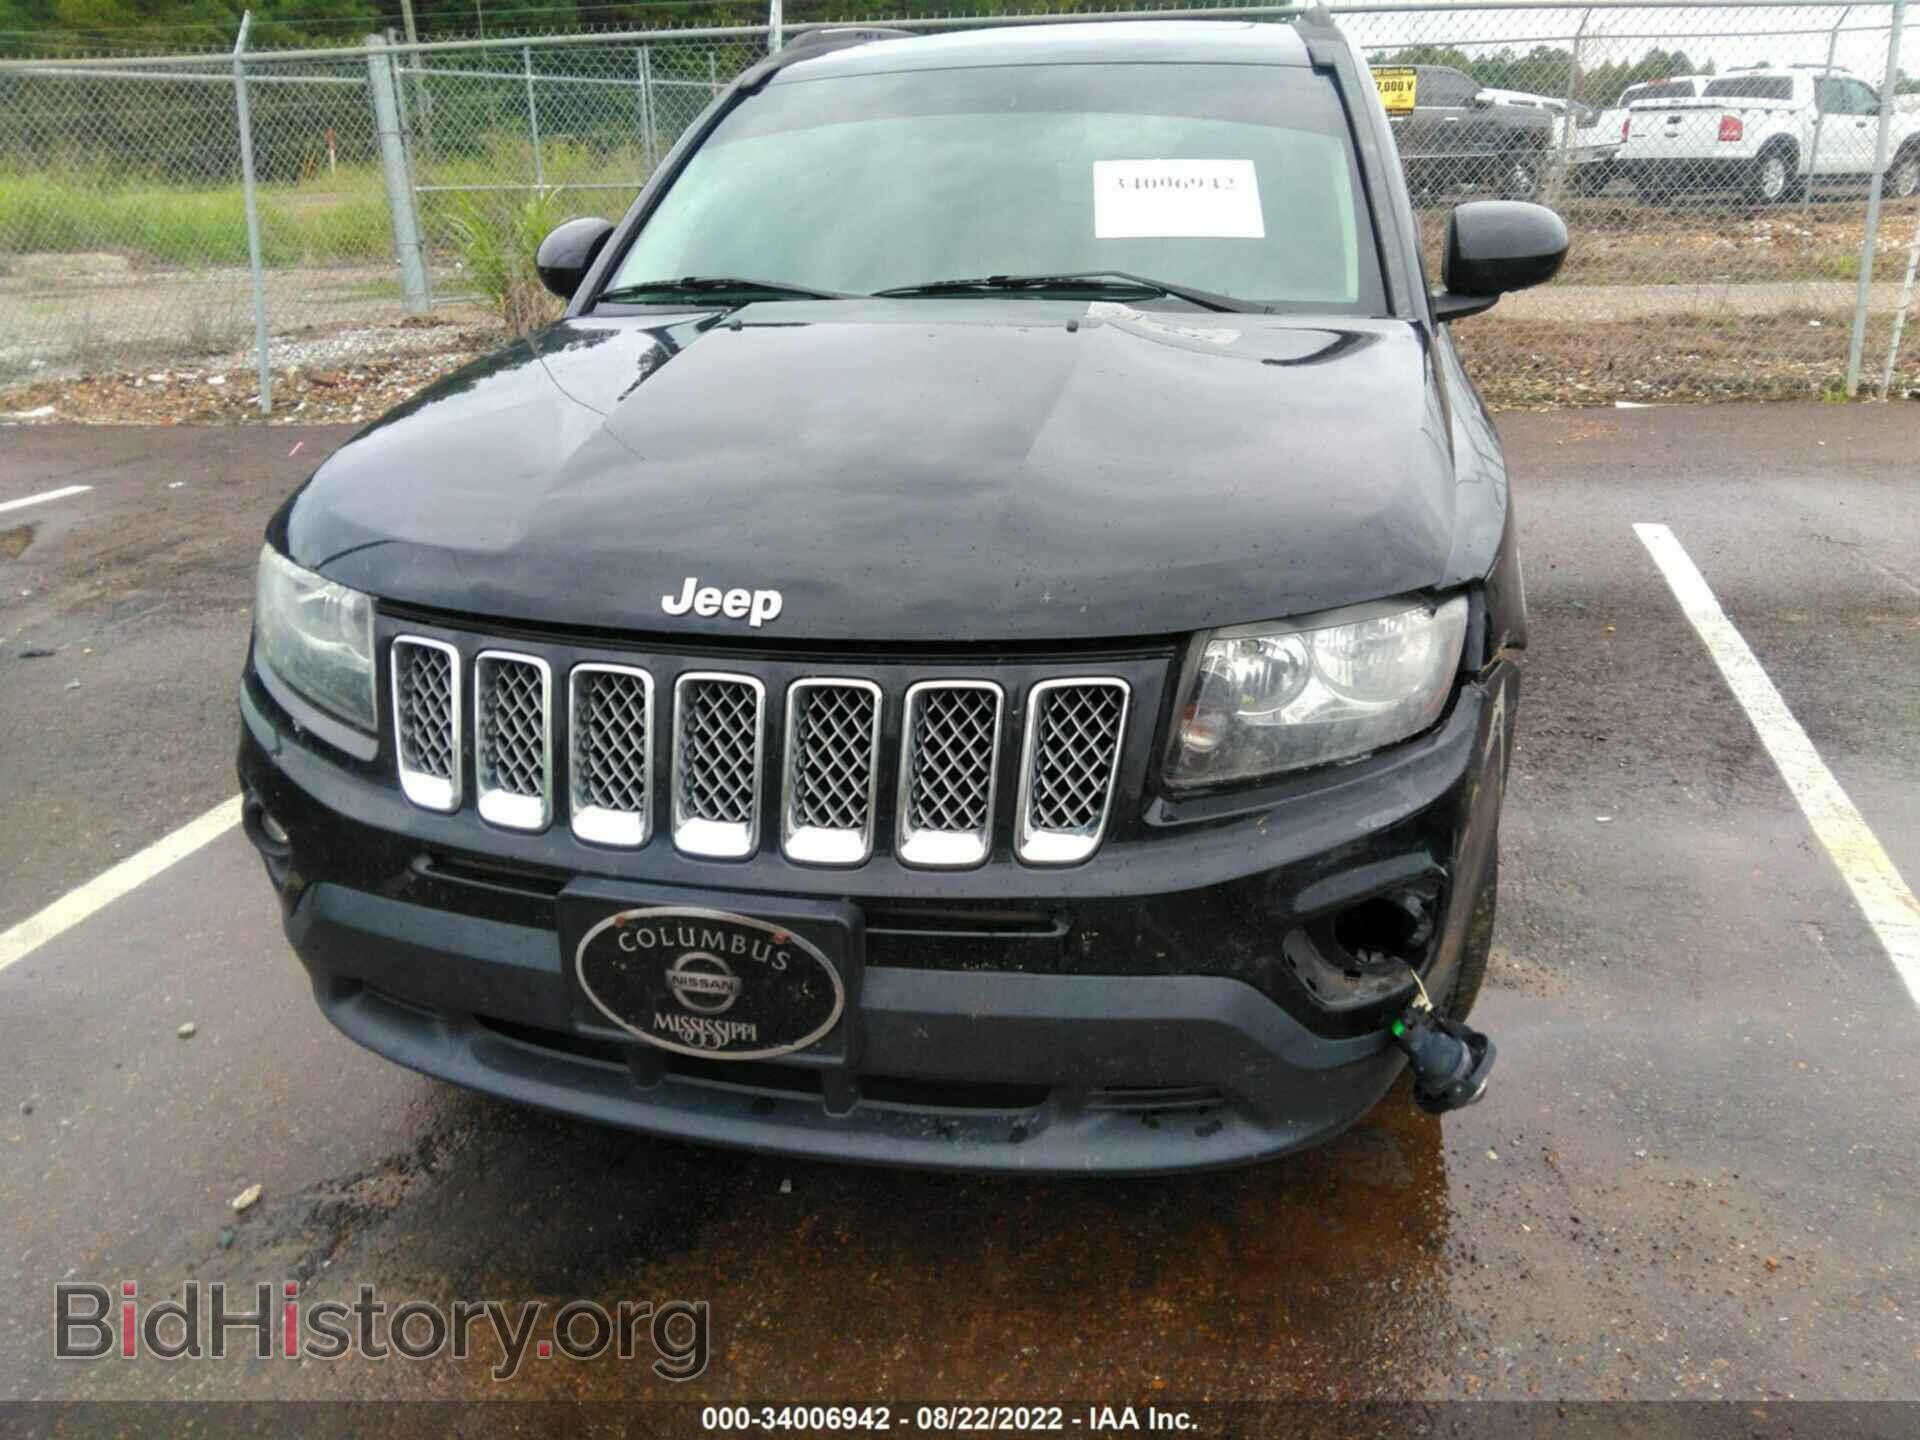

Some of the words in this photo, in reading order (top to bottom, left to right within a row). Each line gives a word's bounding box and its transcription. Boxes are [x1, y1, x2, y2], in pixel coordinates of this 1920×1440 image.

[661, 577, 782, 627] Jeep
[618, 927, 791, 971] COLUMBUS
[671, 974, 735, 993] NISSAN
[653, 1012, 758, 1051] MISSISSIPPI
